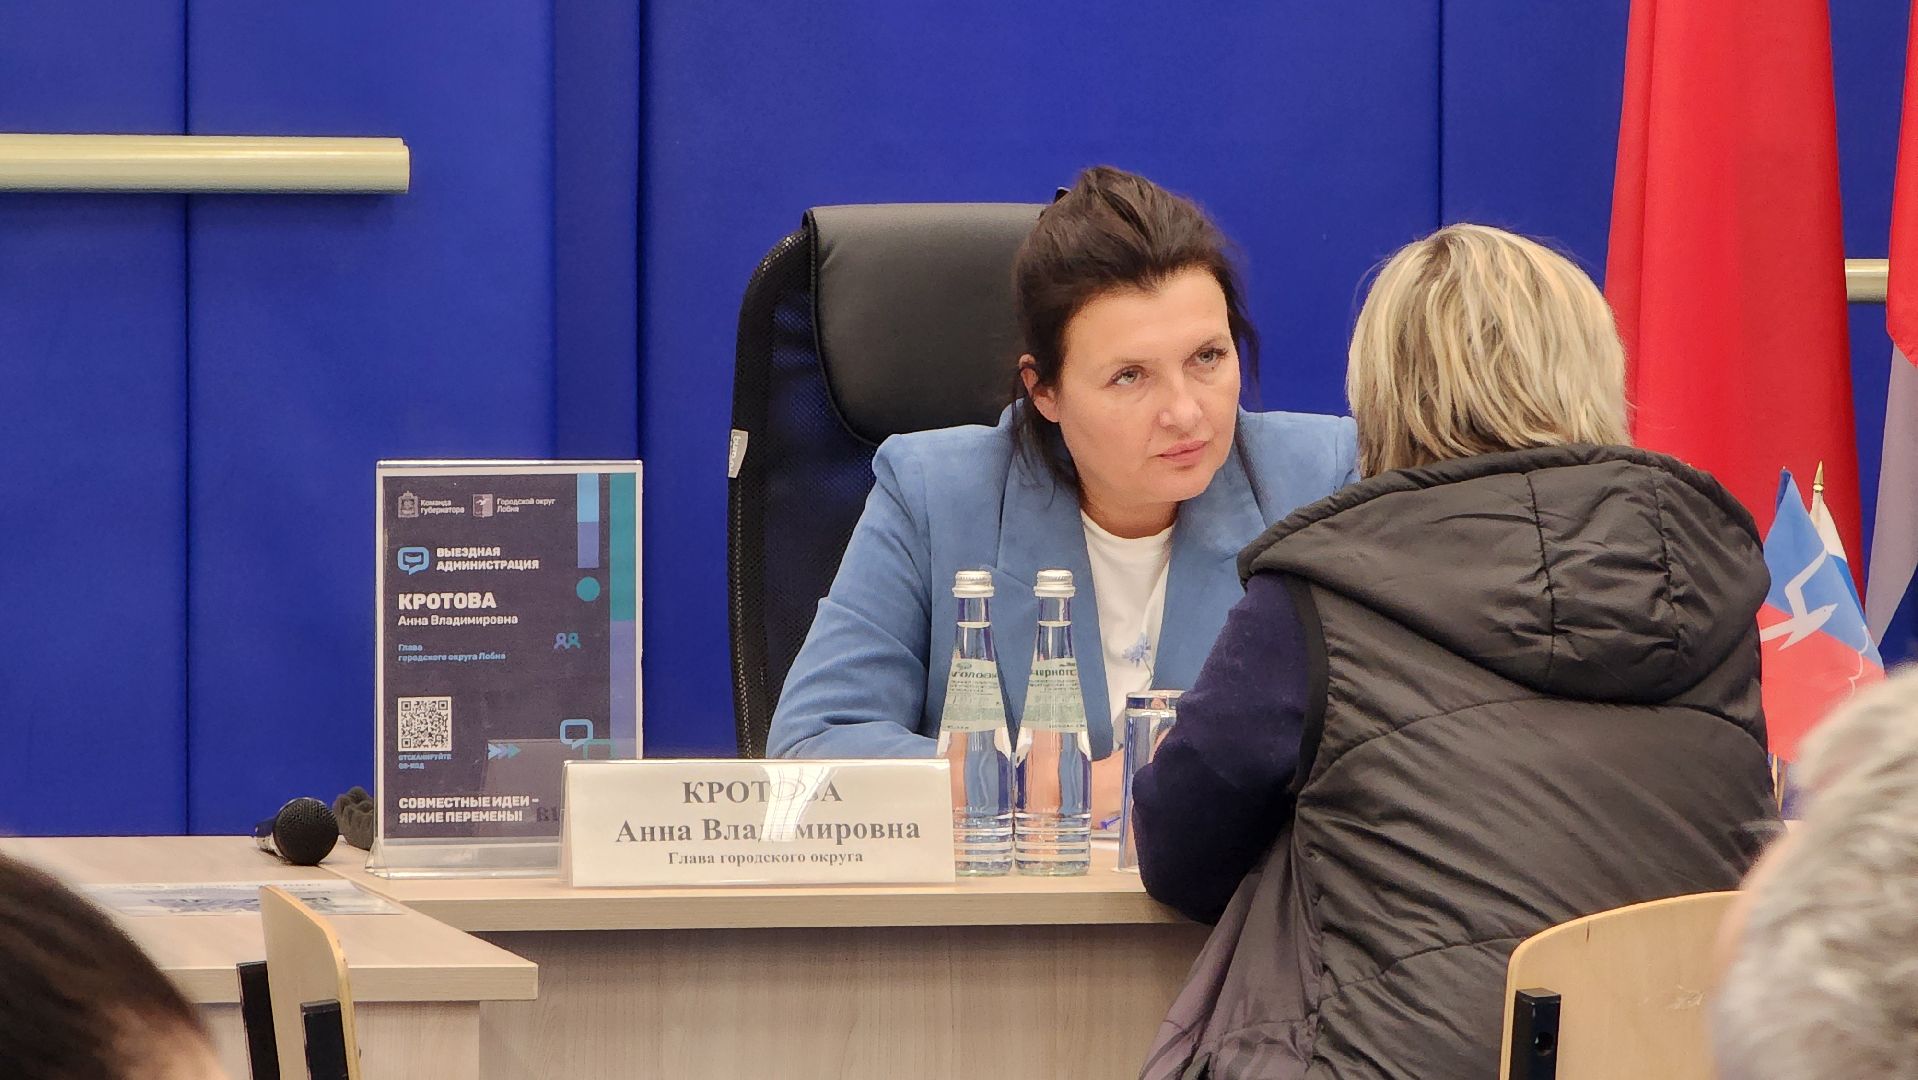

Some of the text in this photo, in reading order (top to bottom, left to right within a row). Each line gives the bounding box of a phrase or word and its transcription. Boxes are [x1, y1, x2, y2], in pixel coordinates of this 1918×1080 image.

[420, 499, 452, 507] Команда
[496, 498, 556, 507] Городской округ
[420, 506, 465, 516] губернатора
[496, 506, 520, 514] Лобня
[436, 547, 501, 558] ВЫЕЗДНАЯ
[436, 559, 540, 572] АДМИНИСТРАЦИЯ
[398, 592, 497, 610] КРОТОВА
[398, 614, 519, 627] Анна Владимировна
[398, 643, 423, 652] Глава
[398, 652, 506, 663] городского округа Лобня
[683, 779, 843, 804] КРОТА
[398, 796, 491, 809] СОВМЕСТНЫЕ
[492, 796, 530, 808] ИДЕИ
[398, 811, 444, 824] ЯРКИЕ
[446, 811, 523, 822] ПЕРЕМЕНЫ!
[615, 817, 921, 846] Анна Вламировна
[668, 851, 864, 867] Глава городского округа
